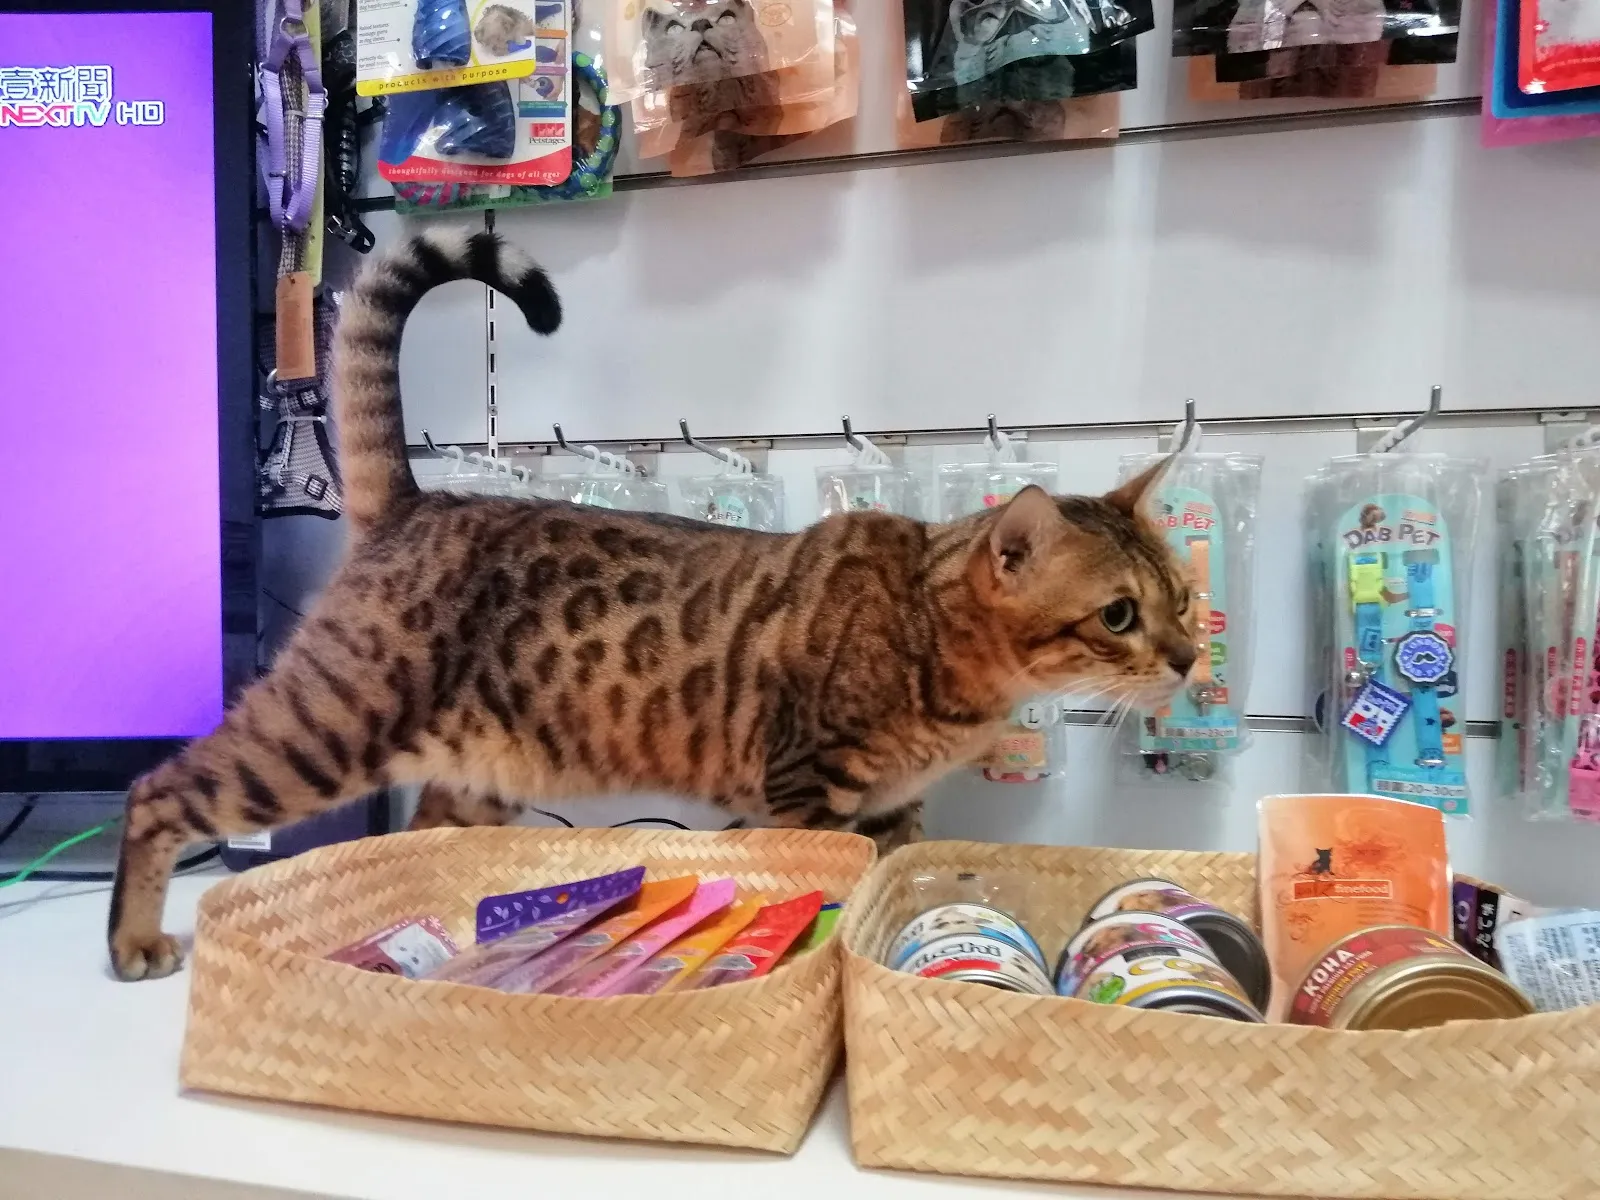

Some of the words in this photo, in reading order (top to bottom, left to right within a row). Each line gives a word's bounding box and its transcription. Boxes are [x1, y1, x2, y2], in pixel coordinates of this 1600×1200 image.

[462, 67, 508, 81] purpose
[0, 67, 111, 102] 壹新聞
[117, 101, 164, 125] HD
[528, 137, 567, 145] Petstages
[388, 166, 439, 176] thoughtfully
[480, 168, 494, 178] for
[498, 169, 515, 179] dogs
[517, 170, 527, 178] of
[527, 170, 540, 178] all
[1182, 512, 1216, 530] PET
[1343, 526, 1393, 550] DAB
[1397, 523, 1441, 546] PET
[1028, 708, 1040, 724] L
[1302, 948, 1355, 998] KOHA
